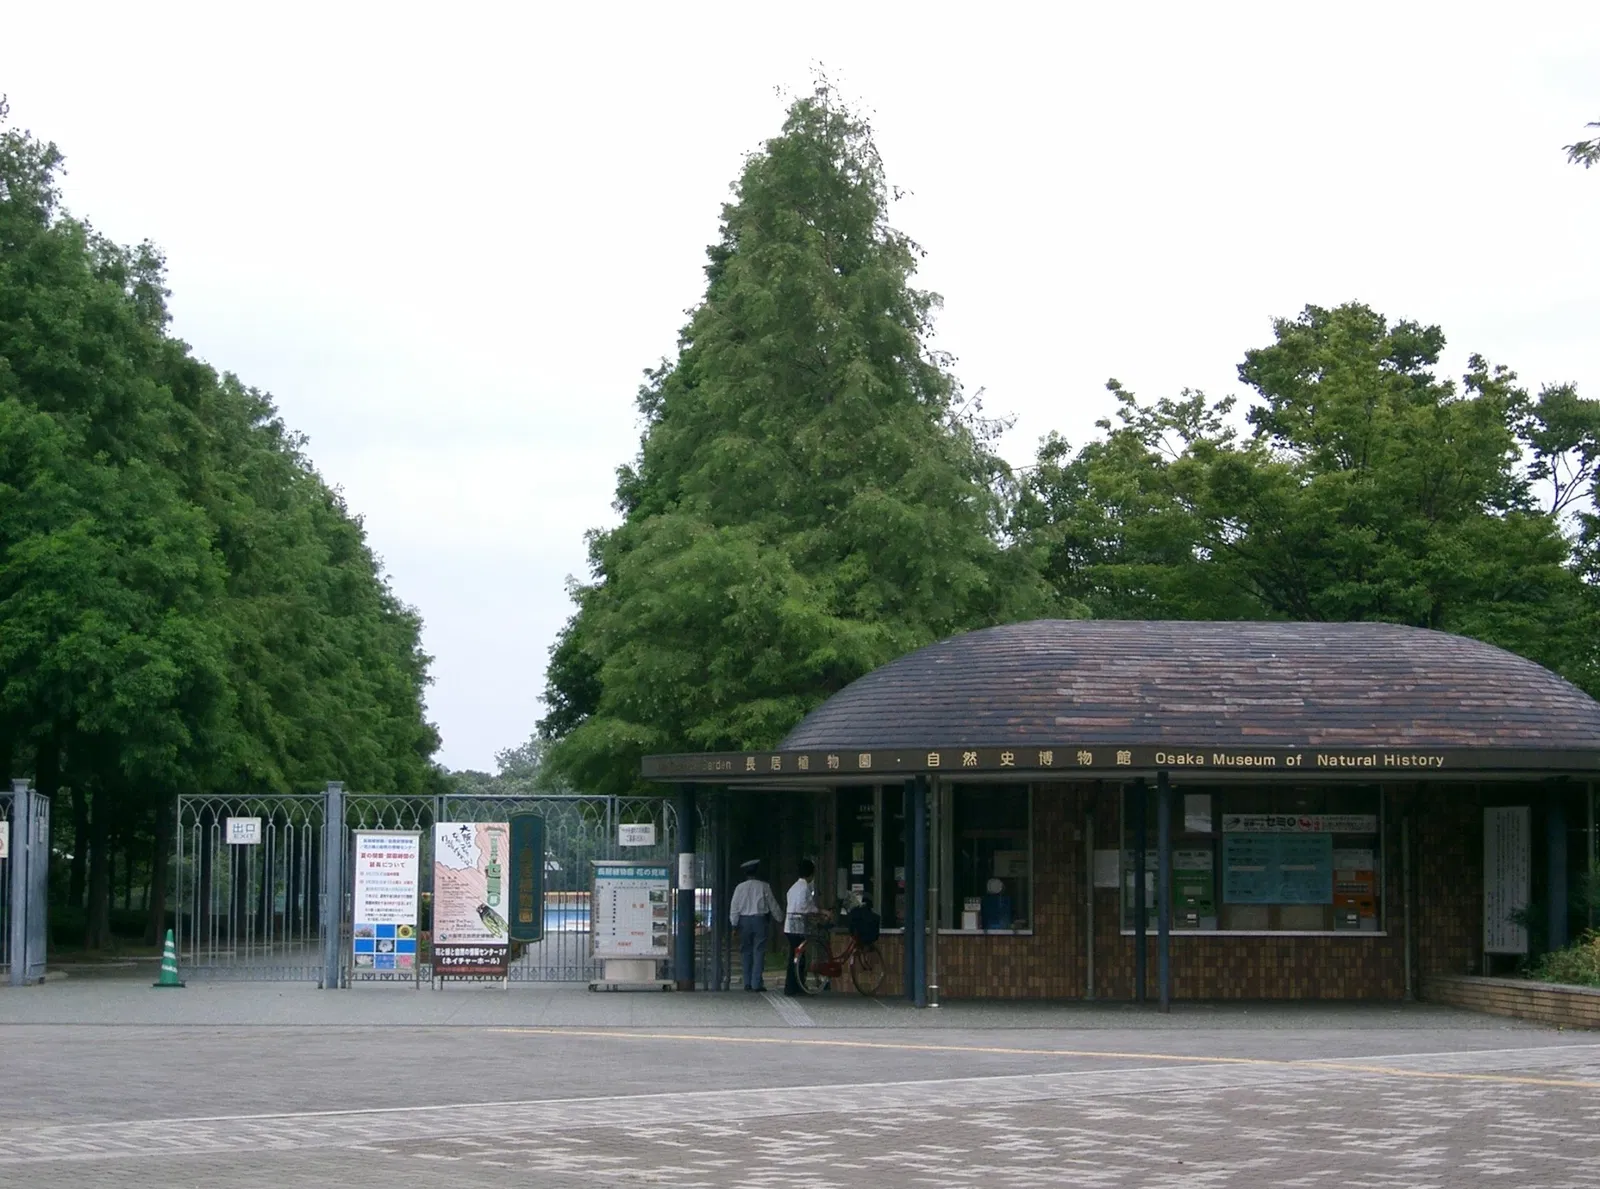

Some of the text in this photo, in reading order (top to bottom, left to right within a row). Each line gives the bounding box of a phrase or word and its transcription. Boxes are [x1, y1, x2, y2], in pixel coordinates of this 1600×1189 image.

[1155, 752, 1444, 767] Osaka Museum of Natural History
[232, 823, 255, 833] 出口
